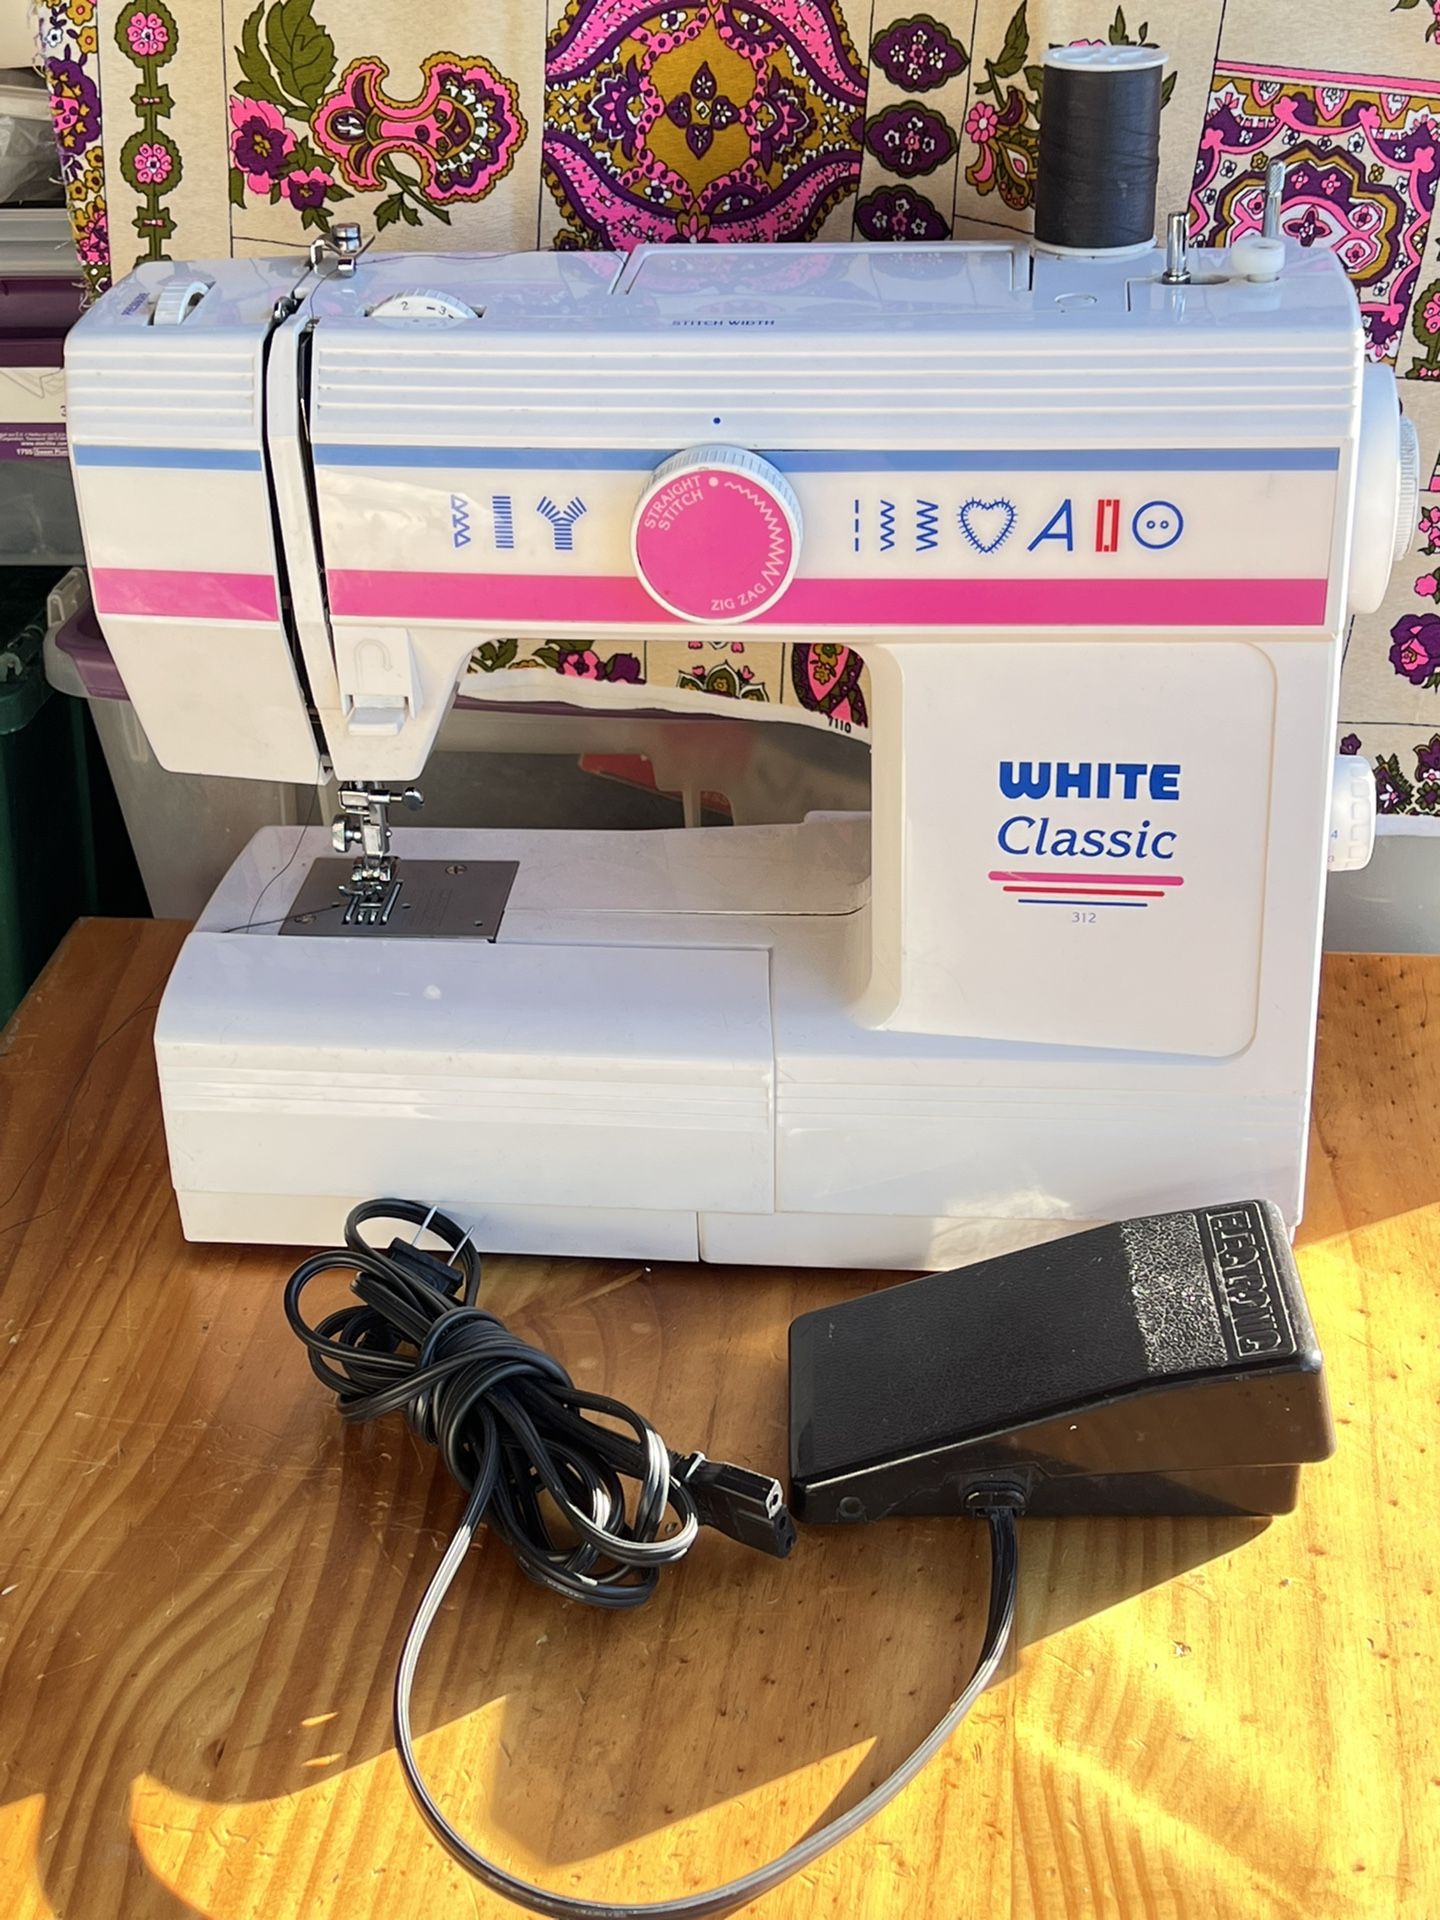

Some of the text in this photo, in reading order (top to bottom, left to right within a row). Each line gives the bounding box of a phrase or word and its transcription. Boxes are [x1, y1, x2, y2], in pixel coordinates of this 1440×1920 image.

[644, 475, 702, 529] STRAIGHT
[658, 489, 704, 531] STITCH
[711, 582, 767, 611] ZIG ZAG
[999, 761, 1181, 801] WHITE
[997, 815, 1178, 860] Classic
[1072, 912, 1096, 924] 312
